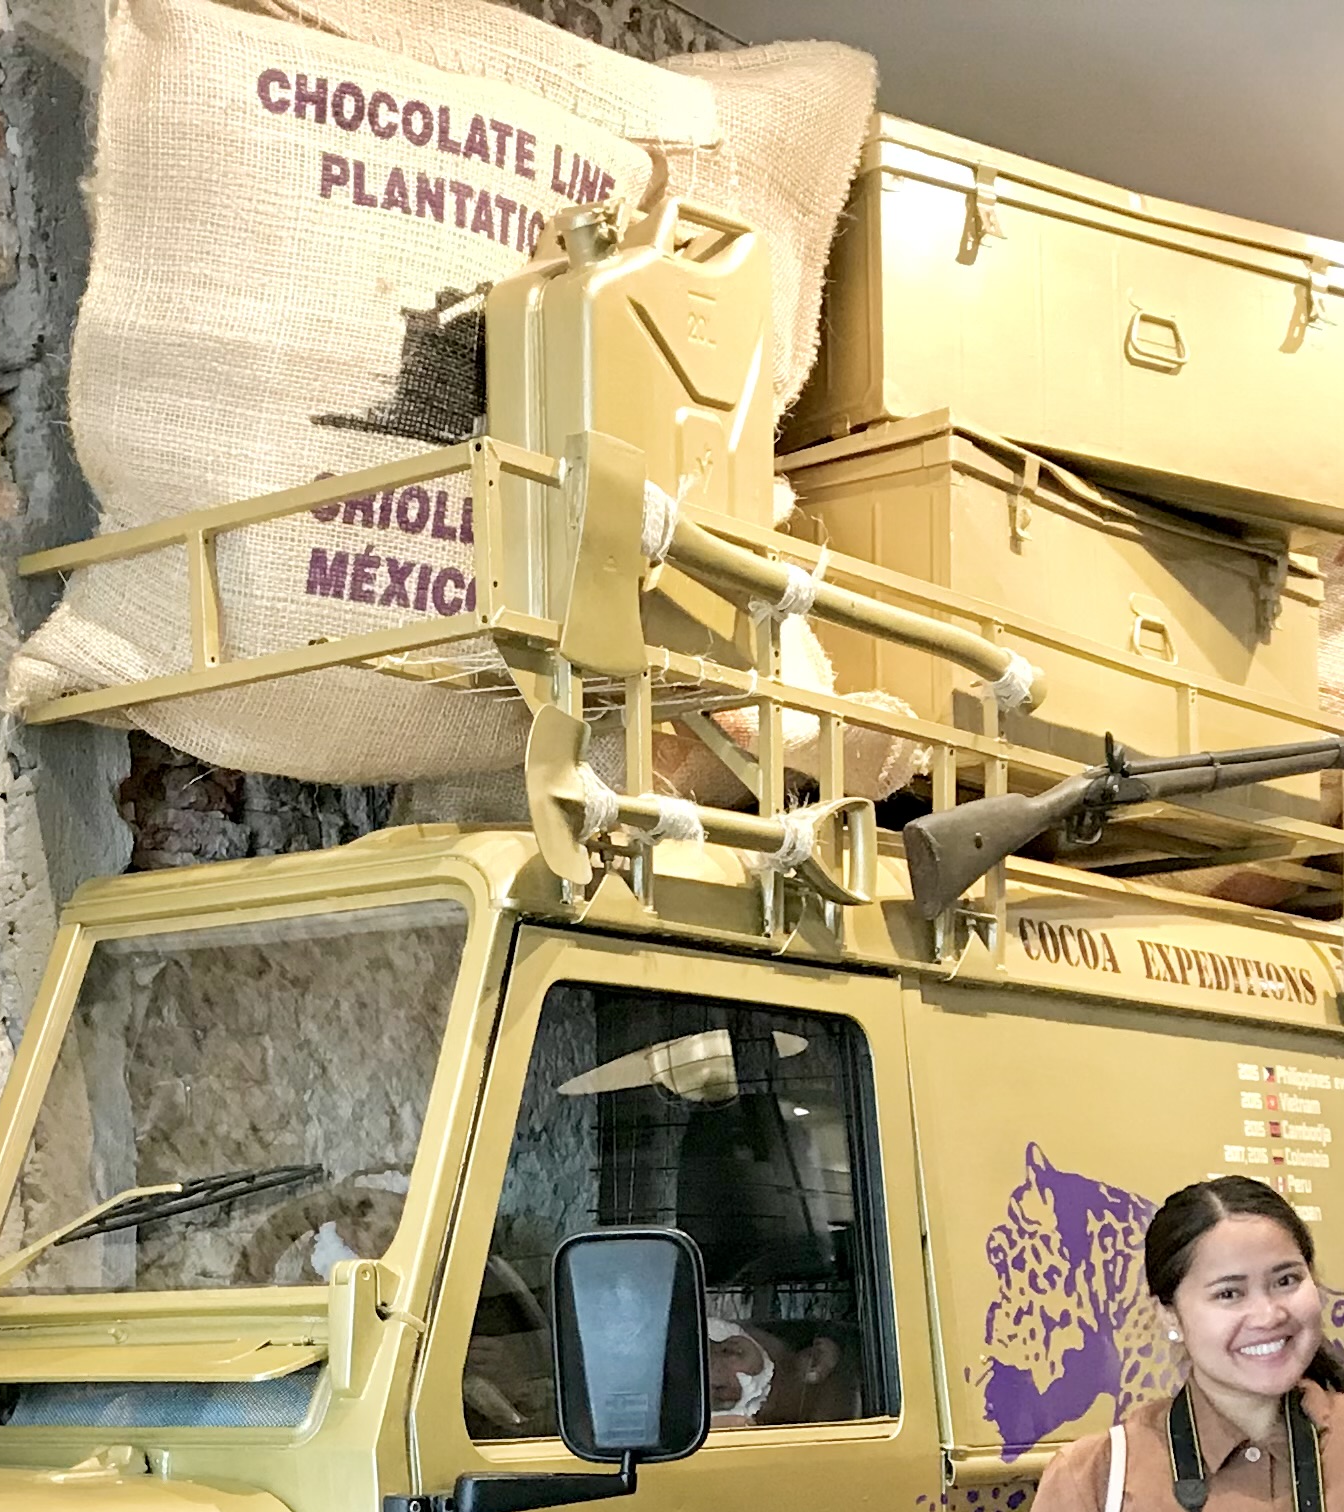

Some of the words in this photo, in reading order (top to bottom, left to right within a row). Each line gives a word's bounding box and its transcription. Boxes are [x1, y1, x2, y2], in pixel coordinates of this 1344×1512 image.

[257, 68, 537, 180] CHOCOLATE
[550, 144, 616, 205] LINE
[319, 151, 545, 260] PLANTATIO
[306, 544, 476, 617] MÉXIC
[1018, 916, 1122, 974] COCOA
[1136, 939, 1318, 1006] EXPEDITIONS
[1275, 1065, 1332, 1090] Philippines
[1278, 1092, 1321, 1115] Vietnam
[1284, 1147, 1330, 1168] Colombia
[1286, 1174, 1313, 1194] Peru
